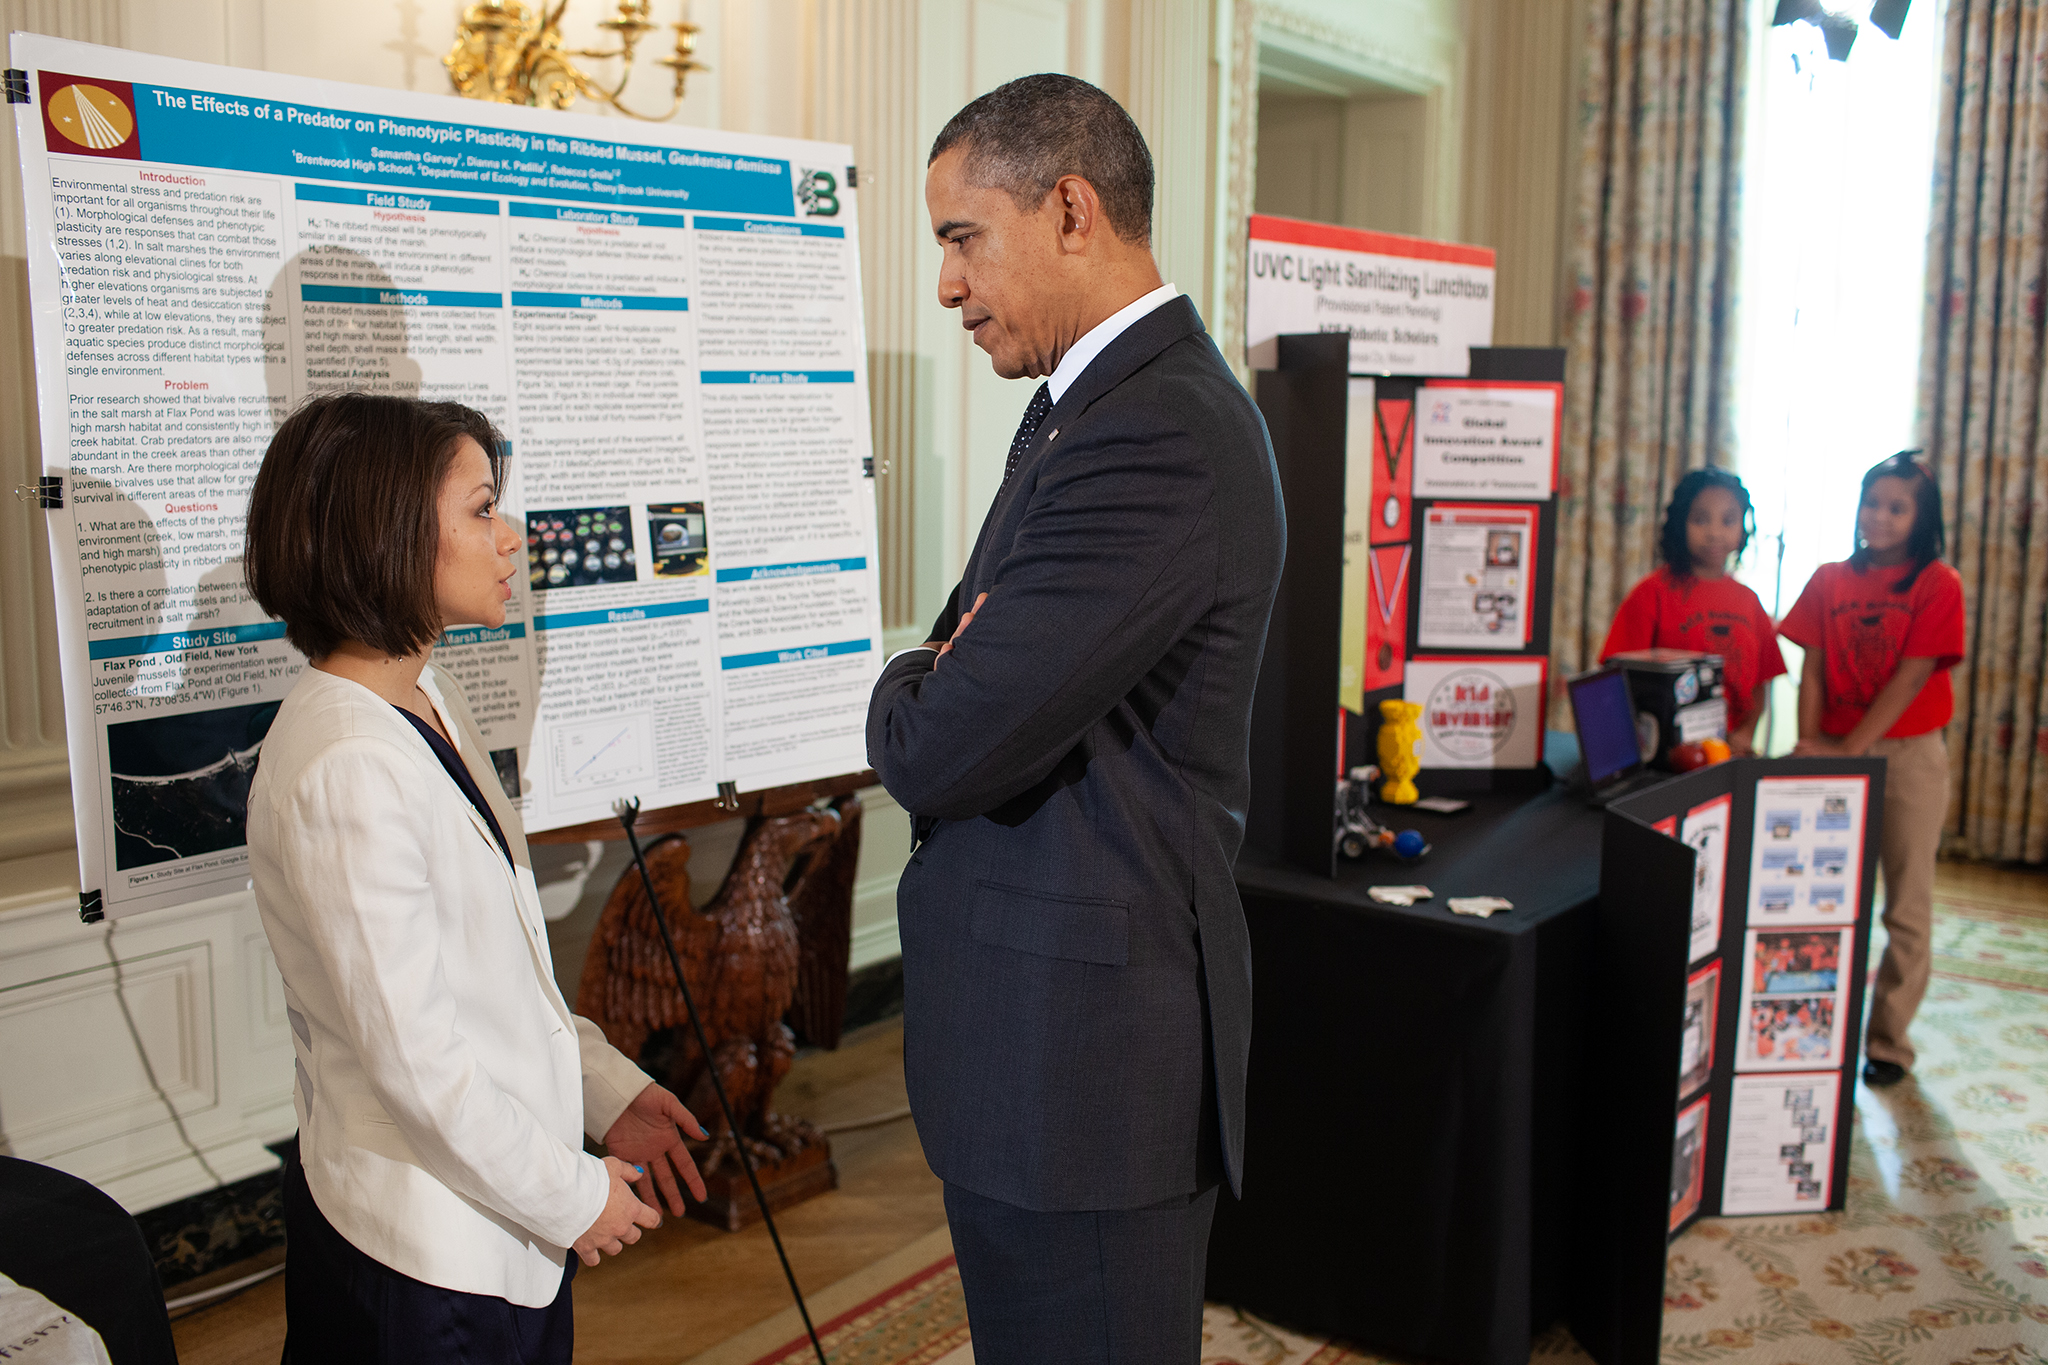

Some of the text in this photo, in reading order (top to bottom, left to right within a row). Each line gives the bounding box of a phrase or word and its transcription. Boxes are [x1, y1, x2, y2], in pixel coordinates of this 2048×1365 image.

[152, 90, 185, 108] The
[191, 95, 248, 115] Effects
[254, 104, 269, 118] of
[274, 109, 282, 120] a
[287, 107, 351, 128] Predator
[355, 120, 374, 132] on
[379, 119, 461, 142] Phenotypic
[466, 129, 528, 152] Plasticity
[531, 136, 544, 150] in
[547, 139, 567, 153] the
[570, 140, 613, 159] Ribbed
[616, 146, 666, 165] Mussel,
[734, 157, 782, 175] demissa
[371, 147, 421, 162] Samantha
[467, 155, 500, 169] Dianna
[502, 159, 511, 170] K.
[140, 171, 205, 186] Introduction
[352, 159, 376, 173] High
[378, 161, 416, 176] School,
[480, 169, 490, 181] of
[492, 172, 529, 187] Ecology
[530, 174, 547, 187] and
[646, 186, 690, 200] University
[52, 177, 127, 192] Environmental
[130, 185, 160, 195] stress
[163, 189, 181, 197] and
[184, 191, 226, 201] predation
[53, 192, 274, 219] important for all organisms throughout their life
[367, 193, 431, 210] Field Study
[55, 206, 264, 232] (1). Morphological defenses and phenotypic
[374, 211, 426, 223] Hypothesis
[557, 208, 639, 226] Laboratory Study
[56, 221, 102, 235] plasticity
[105, 226, 121, 234] are
[124, 227, 175, 238] responses
[177, 230, 195, 239] that
[217, 234, 249, 243] combat
[252, 236, 276, 245] those
[744, 222, 802, 235] Conclusions
[1252, 250, 1489, 300] UVC Light Sanitizing Lunchbox
[380, 292, 428, 305] Methods
[580, 297, 623, 308] Methods
[512, 310, 597, 322] Experimental Design
[67, 365, 164, 377] single environment.
[307, 369, 389, 379] Statistical Analysis
[164, 380, 208, 389] Problem
[782, 374, 808, 384] Study
[69, 394, 286, 404] Prior research showed that bivalve recruitment
[165, 503, 217, 513] Questions
[77, 522, 86, 531] 1.
[89, 521, 117, 530] What
[120, 521, 135, 529] are
[138, 519, 153, 528] the
[156, 518, 186, 527] effects
[189, 516, 198, 525] of
[78, 529, 227, 546] environment (creek, low marsh,
[88, 617, 143, 629] recruitment
[157, 615, 163, 623] a
[166, 613, 182, 622] salt
[186, 608, 219, 620] marsh?
[608, 608, 645, 622] Results
[173, 632, 236, 648] Study Site
[480, 628, 511, 643] Study
[103, 661, 125, 671] Flax
[128, 656, 155, 667] Pond
[164, 653, 182, 663] Old
[184, 650, 211, 661] Field,
[214, 649, 234, 657] New
[237, 645, 257, 654] York
[218, 686, 247, 700] (Figure
[130, 875, 148, 884] Figure
